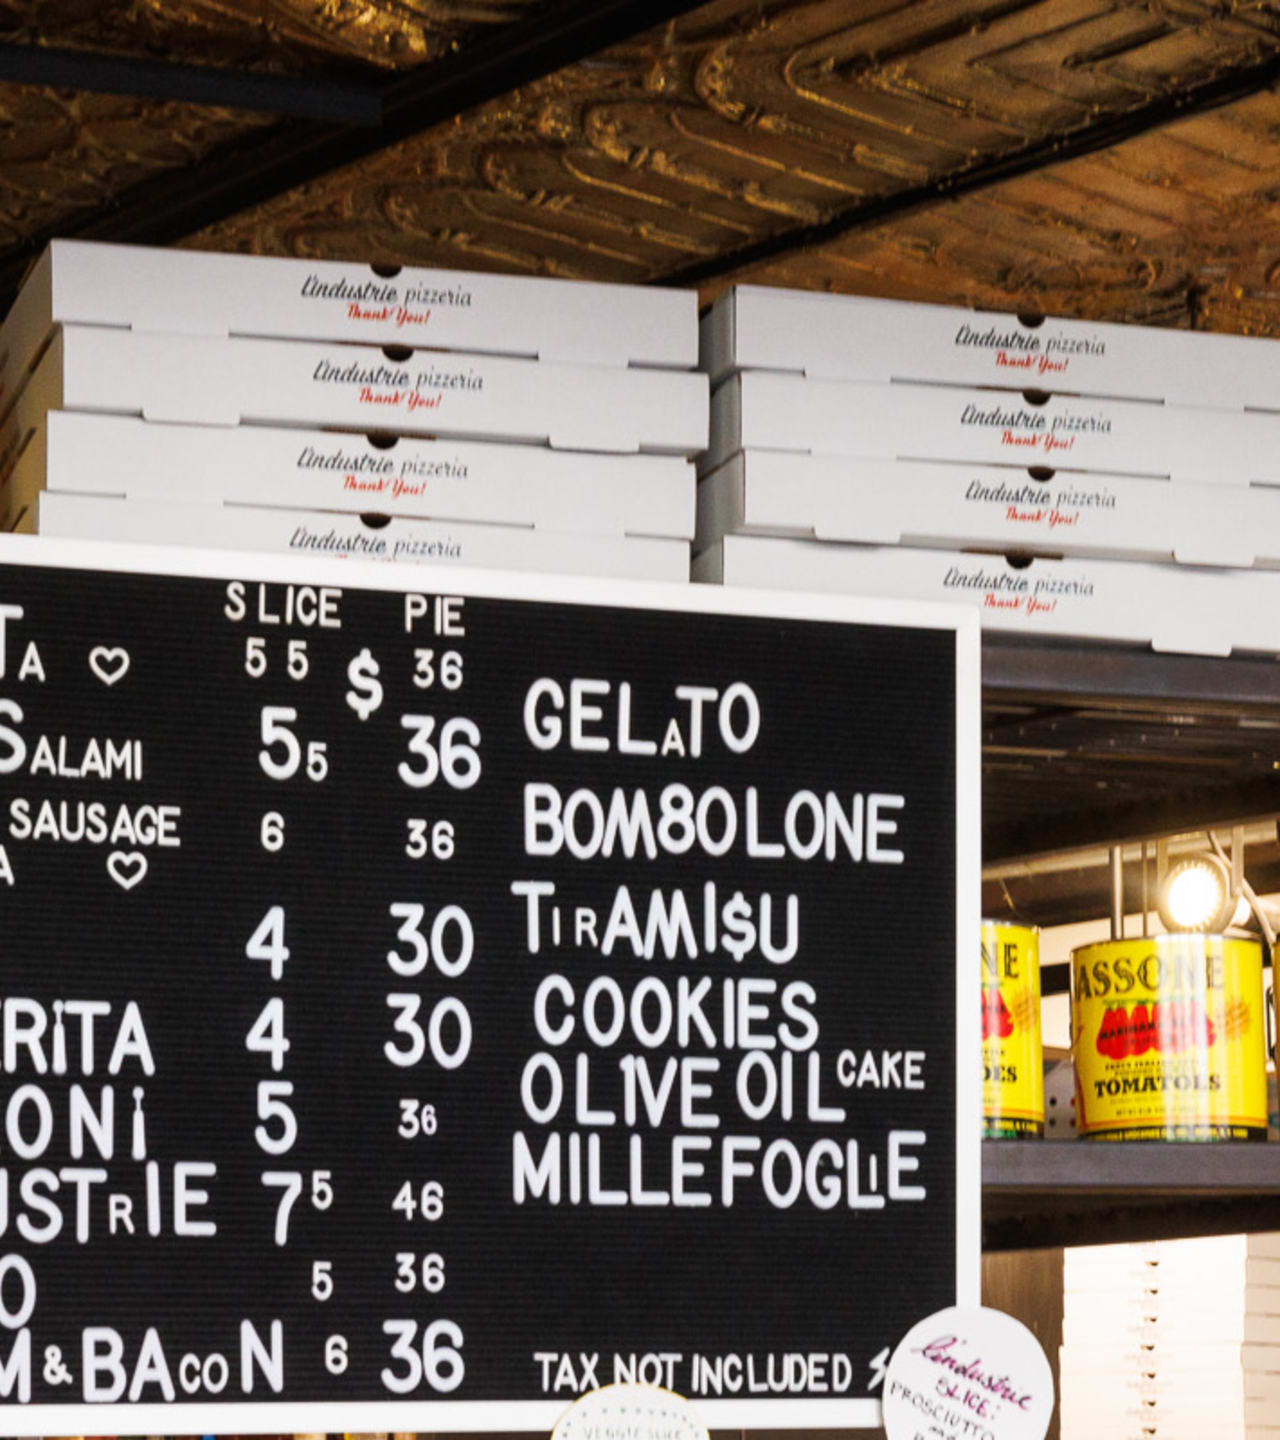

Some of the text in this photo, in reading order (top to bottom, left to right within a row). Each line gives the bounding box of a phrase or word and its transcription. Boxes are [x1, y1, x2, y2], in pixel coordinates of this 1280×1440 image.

[347, 302, 392, 321] Thank
[404, 282, 471, 307] pizzeria
[995, 350, 1038, 368] Thank
[1046, 331, 1105, 356] pizzeria
[359, 387, 404, 405] Thank
[415, 366, 483, 392] pizzeria
[1001, 429, 1043, 446] Thank
[1051, 409, 1111, 434] pizzeria
[401, 454, 469, 479] pizzeria
[1006, 506, 1048, 522] Thank
[1056, 484, 1116, 510] pizzeria
[394, 533, 461, 558] pizzeria
[1034, 572, 1094, 596] pizzeria
[225, 581, 464, 635] SLICE PIE
[414, 649, 462, 689] 36
[524, 678, 760, 757] GELATO
[398, 715, 481, 789] 36
[10, 799, 180, 846] SAUSAGE
[261, 812, 284, 851] 6
[406, 819, 454, 859] 36
[246, 907, 289, 980] 4
[387, 903, 473, 977] 30
[534, 974, 819, 1051] COOKIES
[246, 998, 290, 1071] 4
[384, 994, 472, 1069] 30
[736, 1050, 846, 1123] OIL
[837, 1050, 925, 1089] CAKE
[255, 1081, 297, 1154] 5
[399, 1100, 437, 1138] 36
[392, 1181, 443, 1220] 46
[312, 1261, 333, 1300] 5
[395, 1253, 445, 1292] 36
[325, 1335, 348, 1374] 6
[381, 1320, 464, 1393] 36
[534, 1352, 852, 1395] TAX NOT INCLUDED
